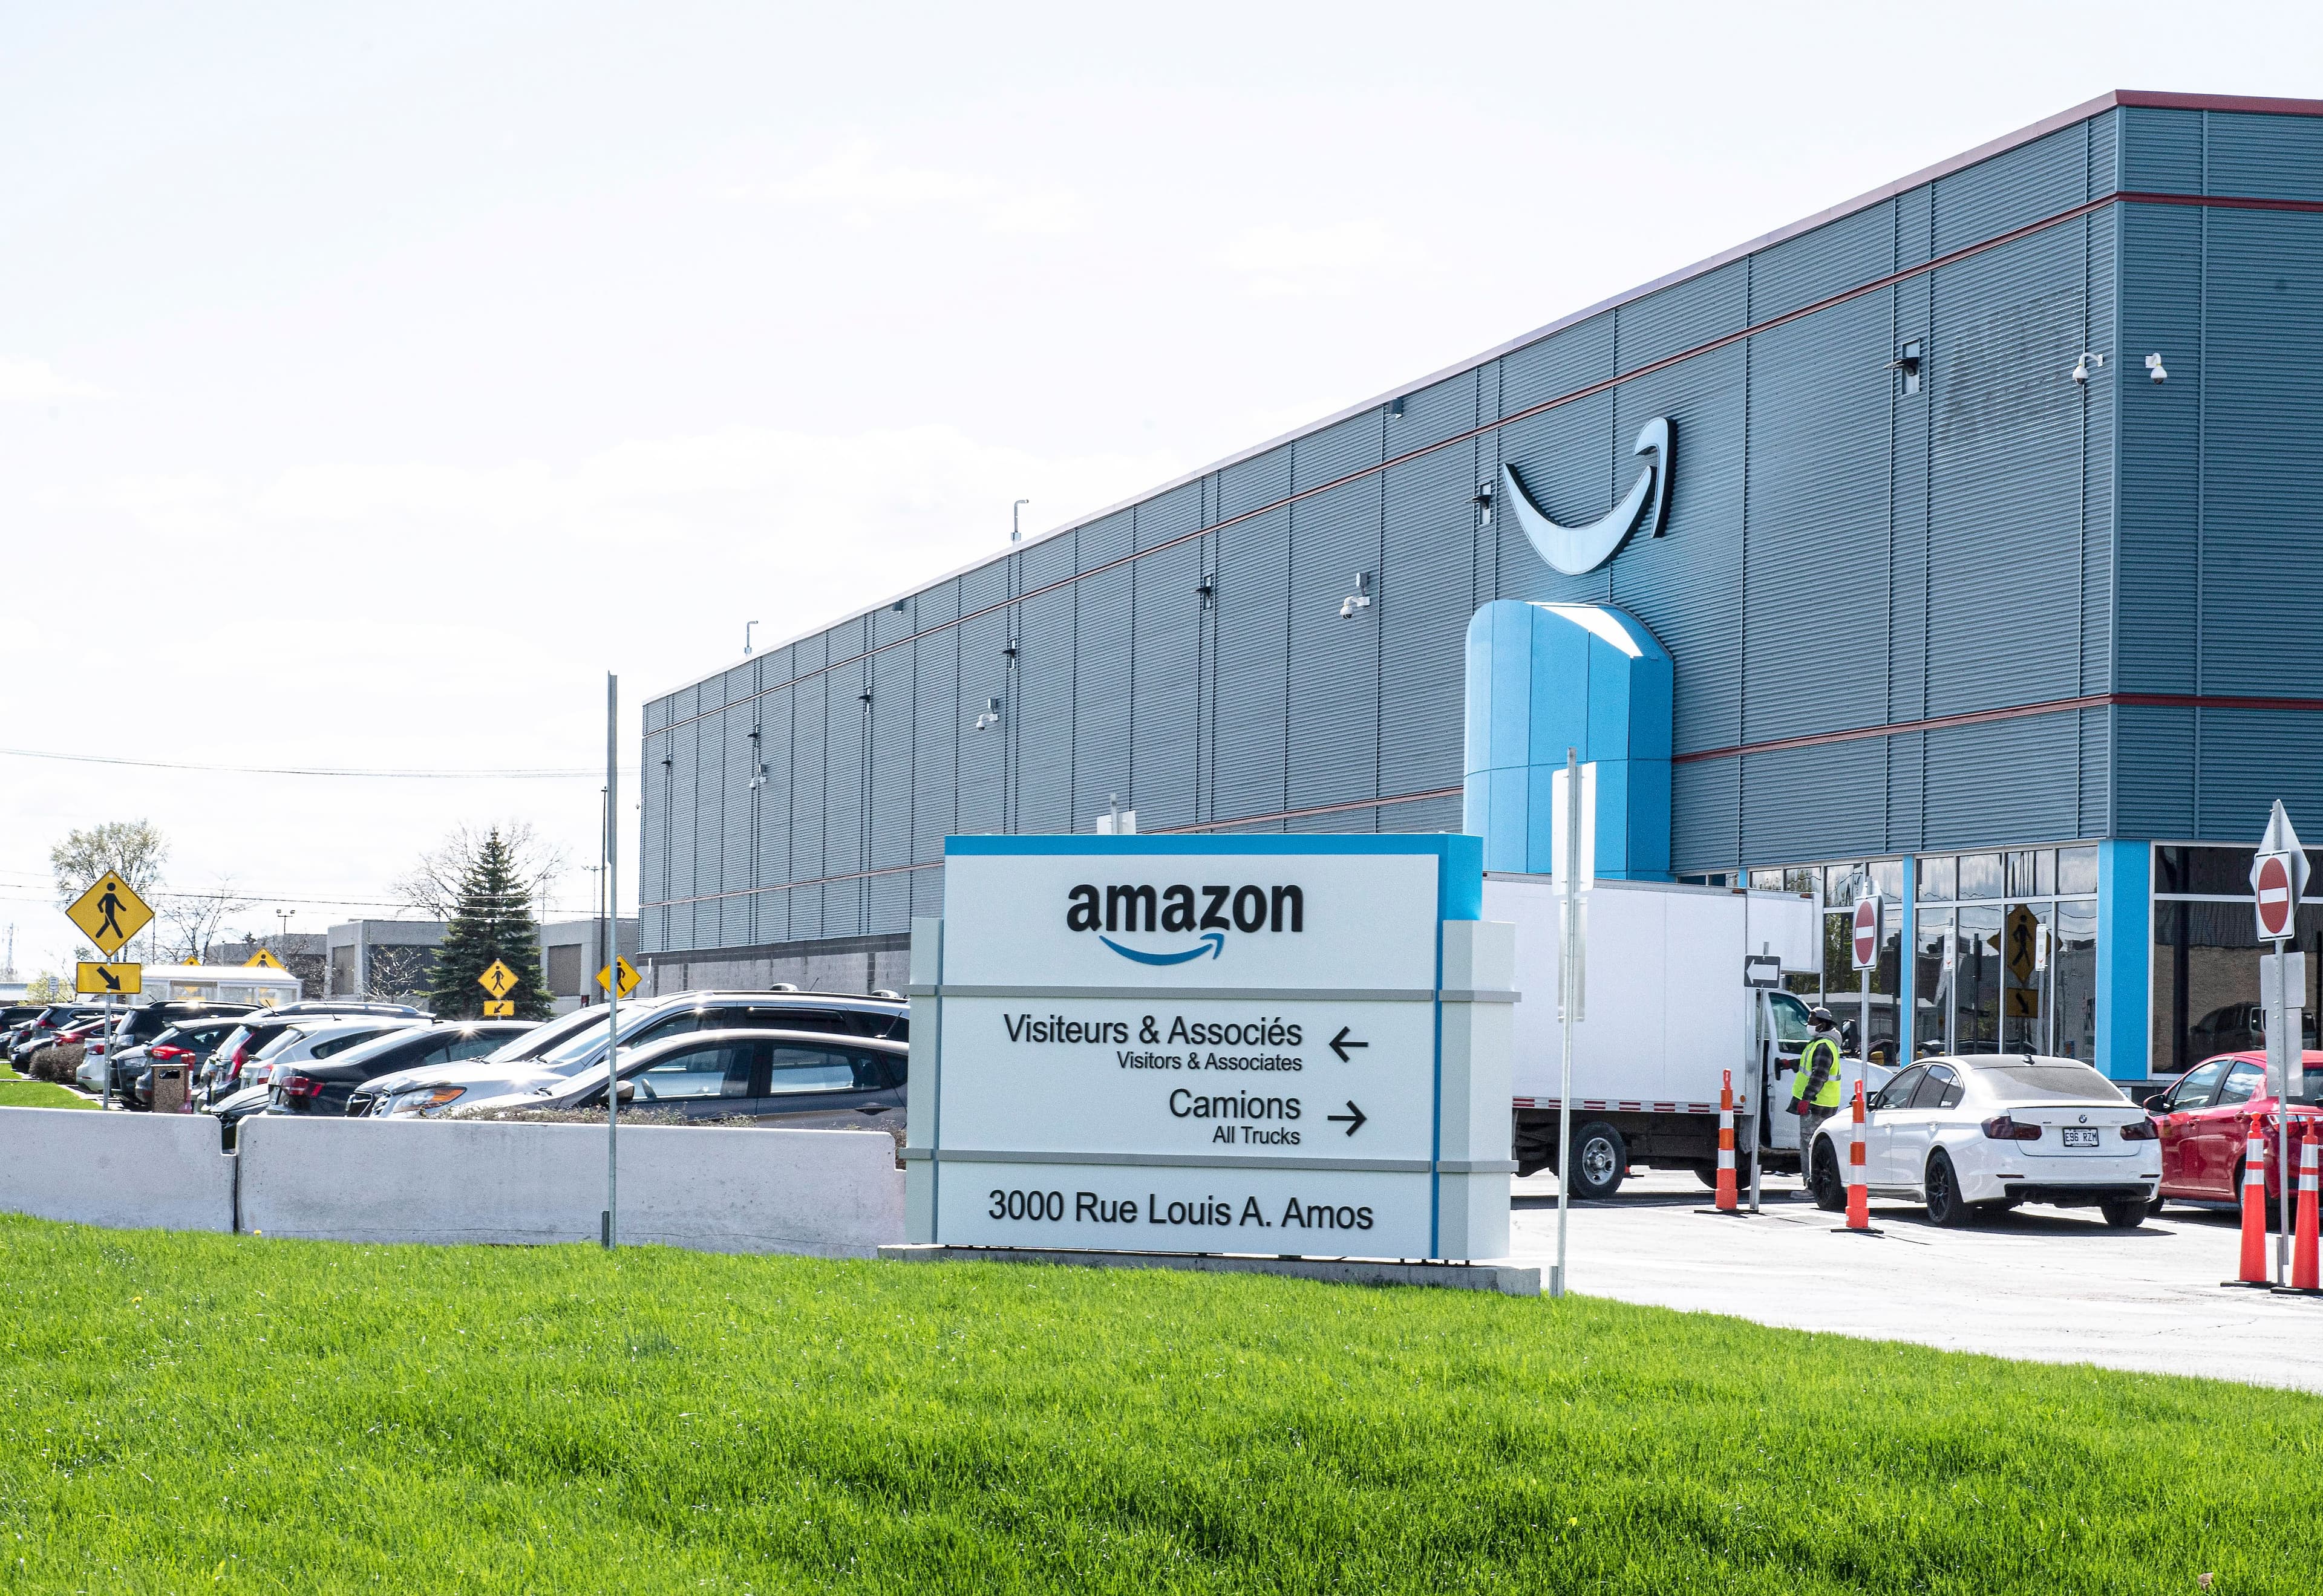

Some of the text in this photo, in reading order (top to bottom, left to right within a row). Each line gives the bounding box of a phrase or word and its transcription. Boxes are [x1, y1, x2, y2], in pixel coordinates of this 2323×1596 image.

[1067, 884, 1304, 933] amazon
[1003, 1014, 1302, 1046] Visiteurs & Associés
[1116, 1050, 1302, 1072] Visitors & Associates
[1169, 1088, 1301, 1120] Camions
[1212, 1125, 1301, 1145] All Trucks
[2065, 1132, 2079, 1142] E96
[988, 1189, 1374, 1230] 3000 Rue Louis A. Amos
